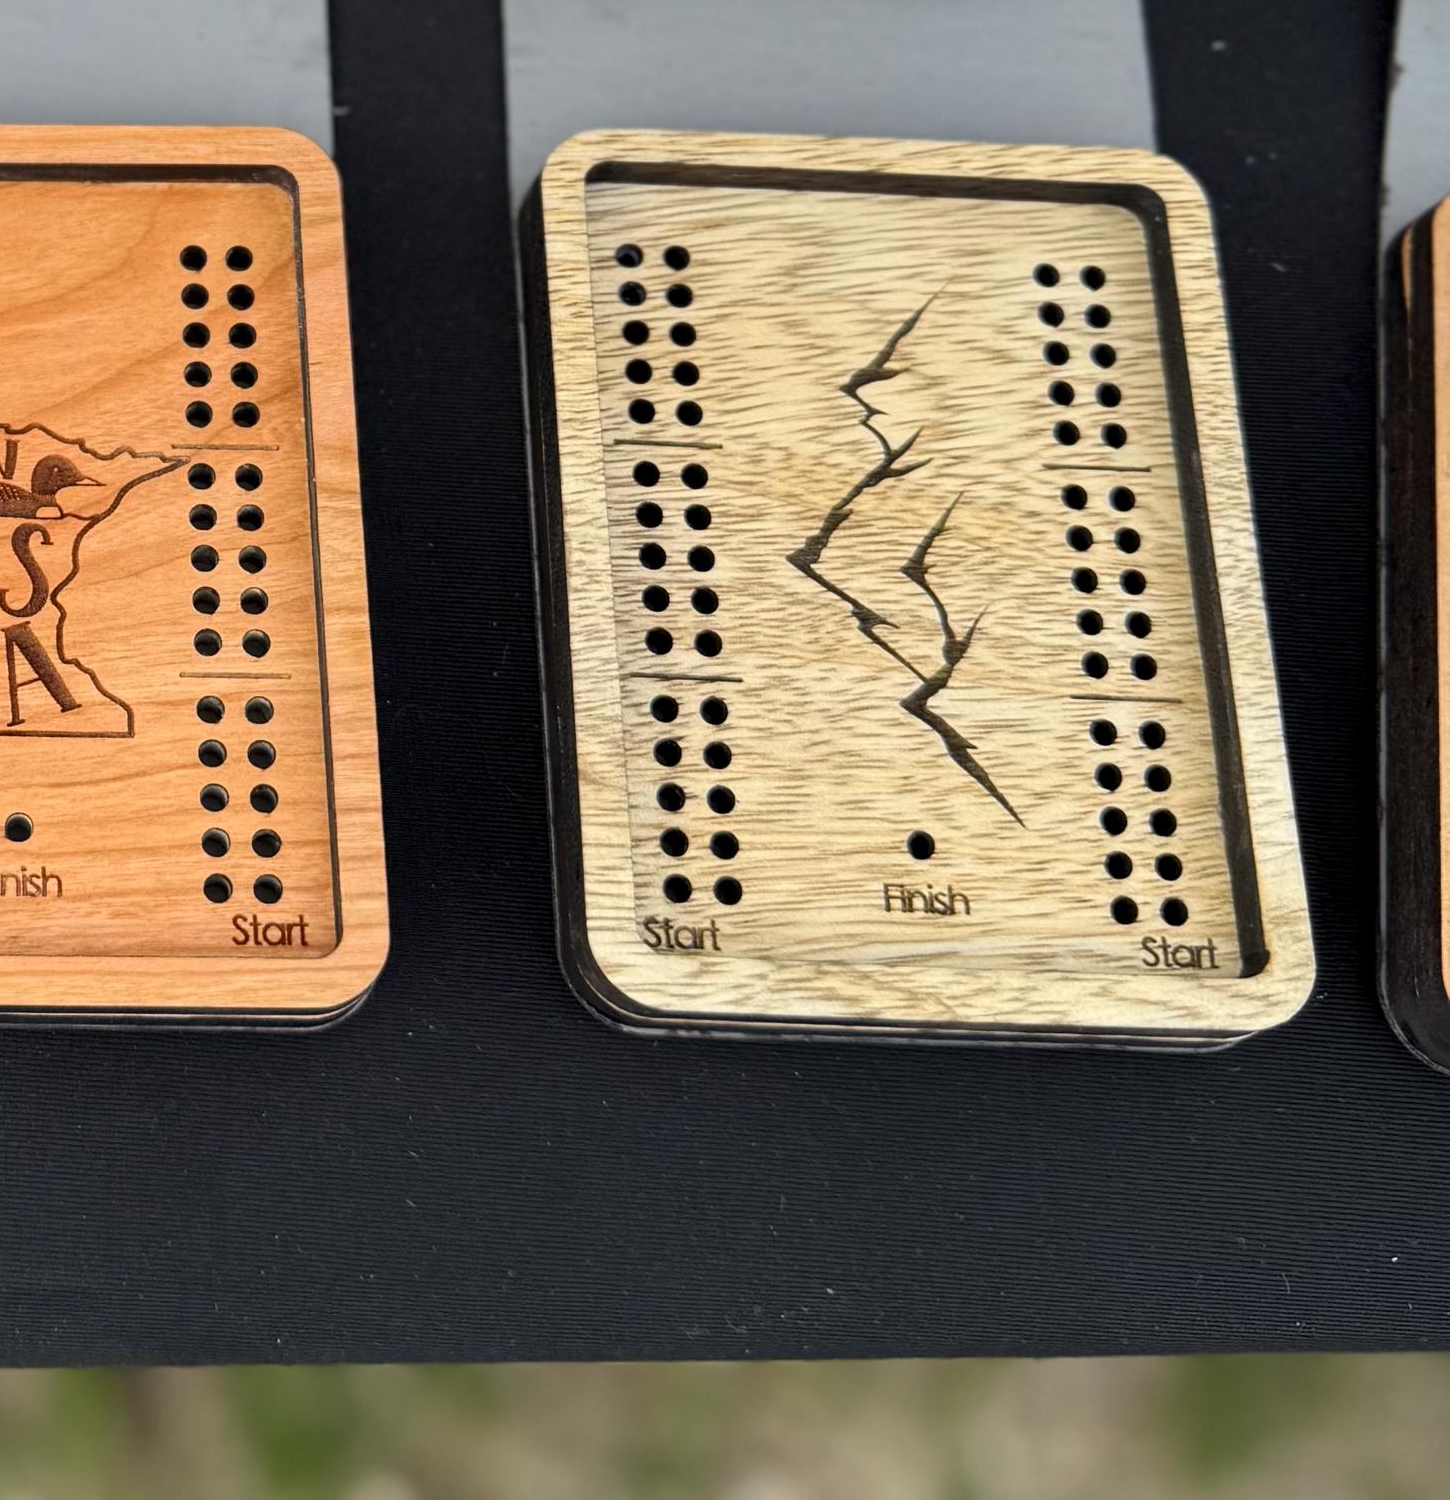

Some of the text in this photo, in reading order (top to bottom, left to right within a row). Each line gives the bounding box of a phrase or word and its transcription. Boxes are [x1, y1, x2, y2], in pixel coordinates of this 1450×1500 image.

[882, 882, 971, 917] Finish
[231, 913, 310, 948] Start
[642, 915, 721, 952] Start
[1140, 935, 1220, 970] Start
